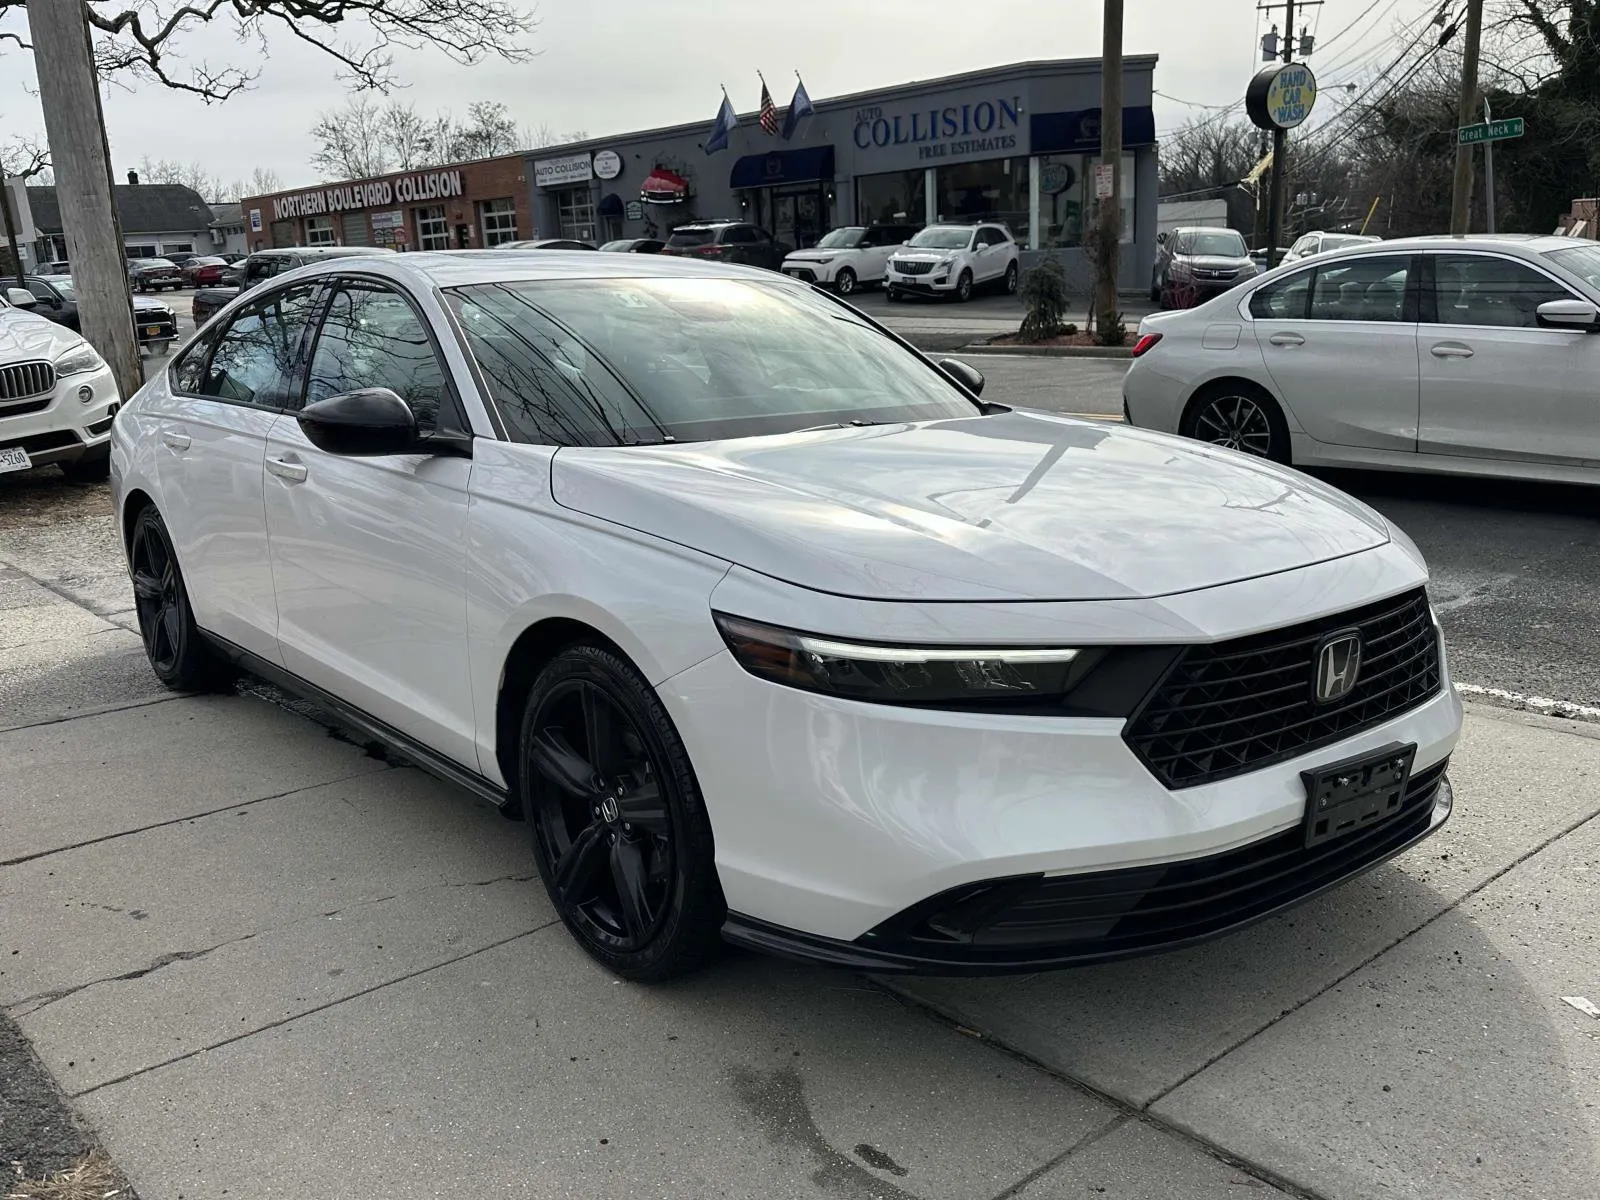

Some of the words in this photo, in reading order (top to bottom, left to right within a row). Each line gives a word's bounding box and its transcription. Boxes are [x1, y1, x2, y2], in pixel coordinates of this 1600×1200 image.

[1280, 70, 1307, 88] HAND
[1283, 87, 1301, 105] CAR
[855, 106, 882, 122] AUTO
[1277, 103, 1305, 122] WASH
[854, 96, 1020, 149] COLLISION
[1460, 128, 1483, 141] Great
[1487, 123, 1509, 137] Neck
[918, 144, 948, 160] FREE
[950, 134, 1017, 155] ESTIMATES
[536, 166, 554, 176] AUTO
[555, 159, 591, 174] COLLISION
[273, 191, 326, 220] NORTHERN
[327, 181, 392, 212] BOULEVARD
[394, 170, 462, 203] COLLISION
